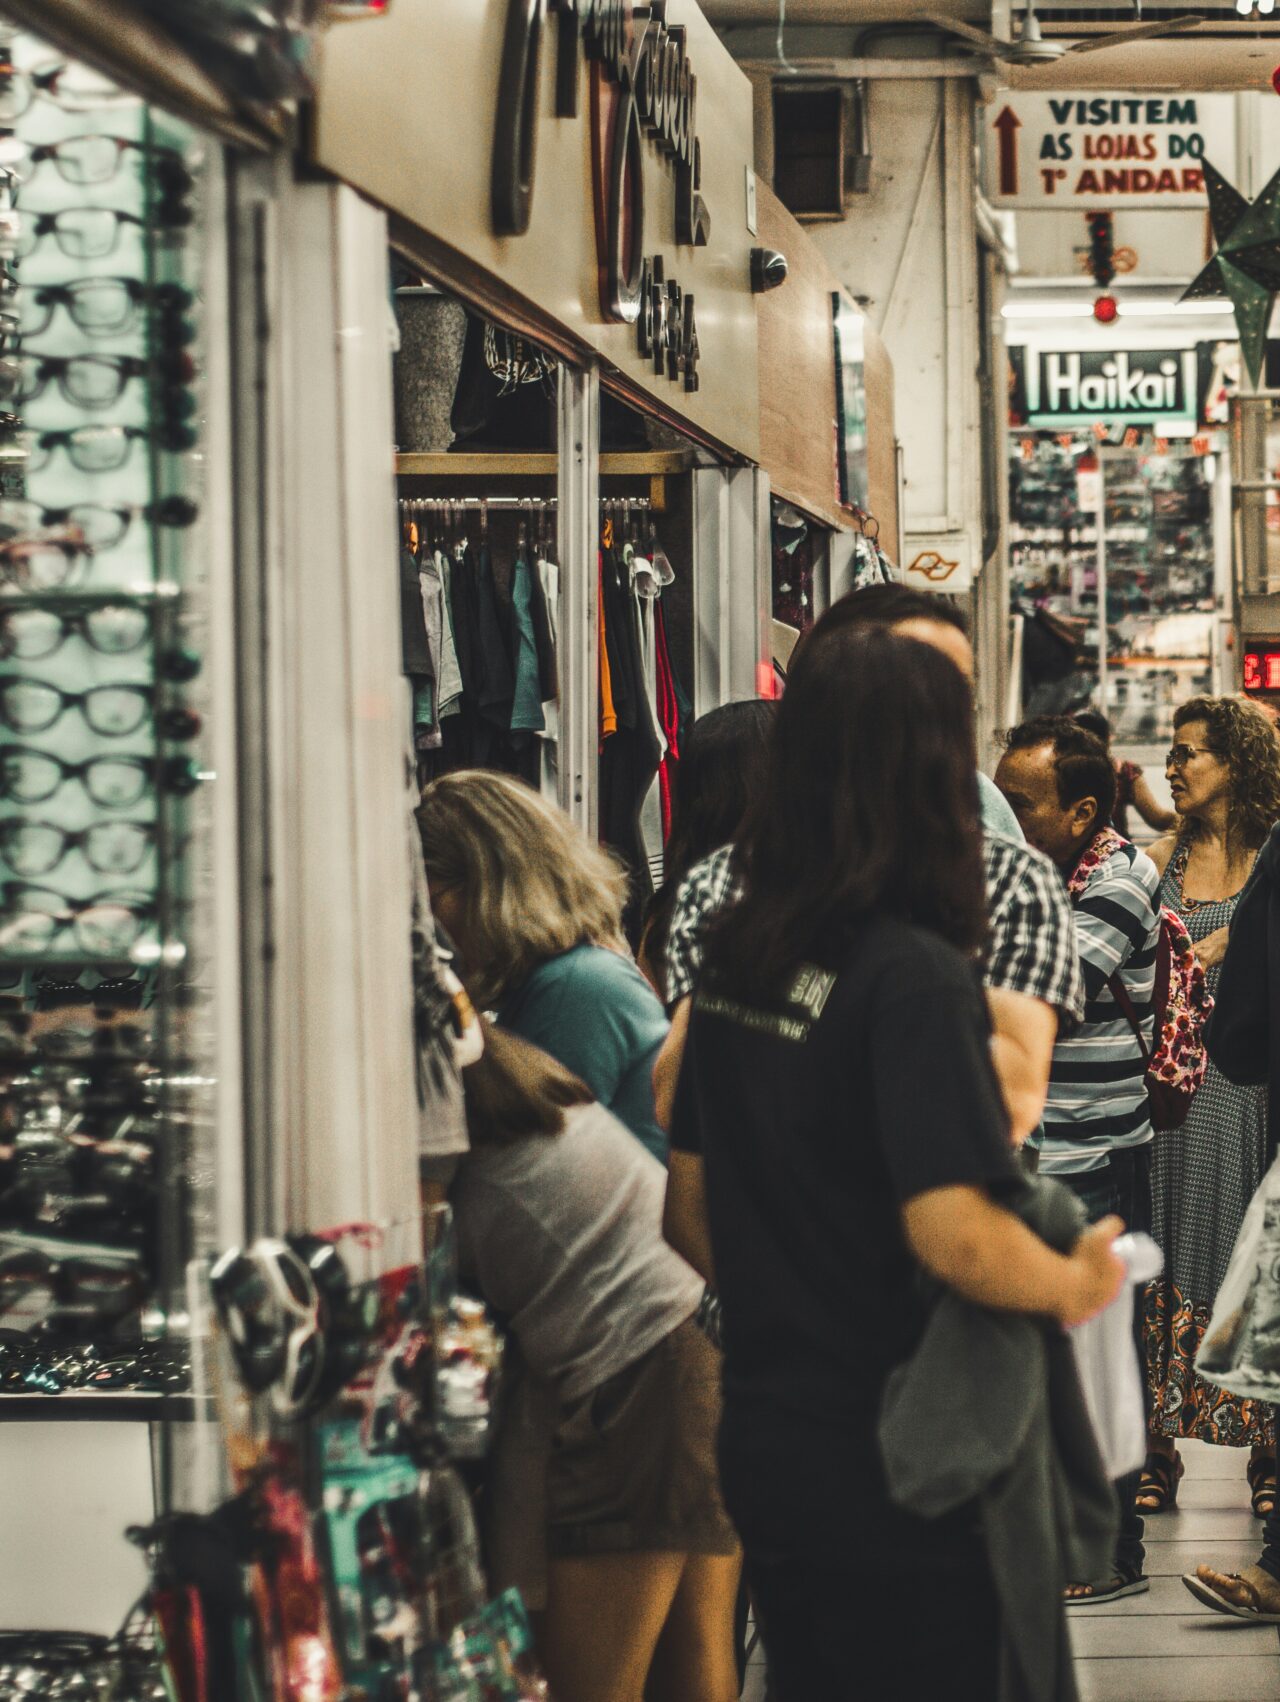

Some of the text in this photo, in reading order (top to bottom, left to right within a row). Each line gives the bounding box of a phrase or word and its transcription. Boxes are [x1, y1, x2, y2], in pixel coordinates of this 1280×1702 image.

[1049, 99, 1197, 125] VISITEM
[1039, 133, 1205, 161] AS LOJAS DO
[1075, 168, 1206, 193] ANDAR
[1047, 352, 1177, 411] Haikai
